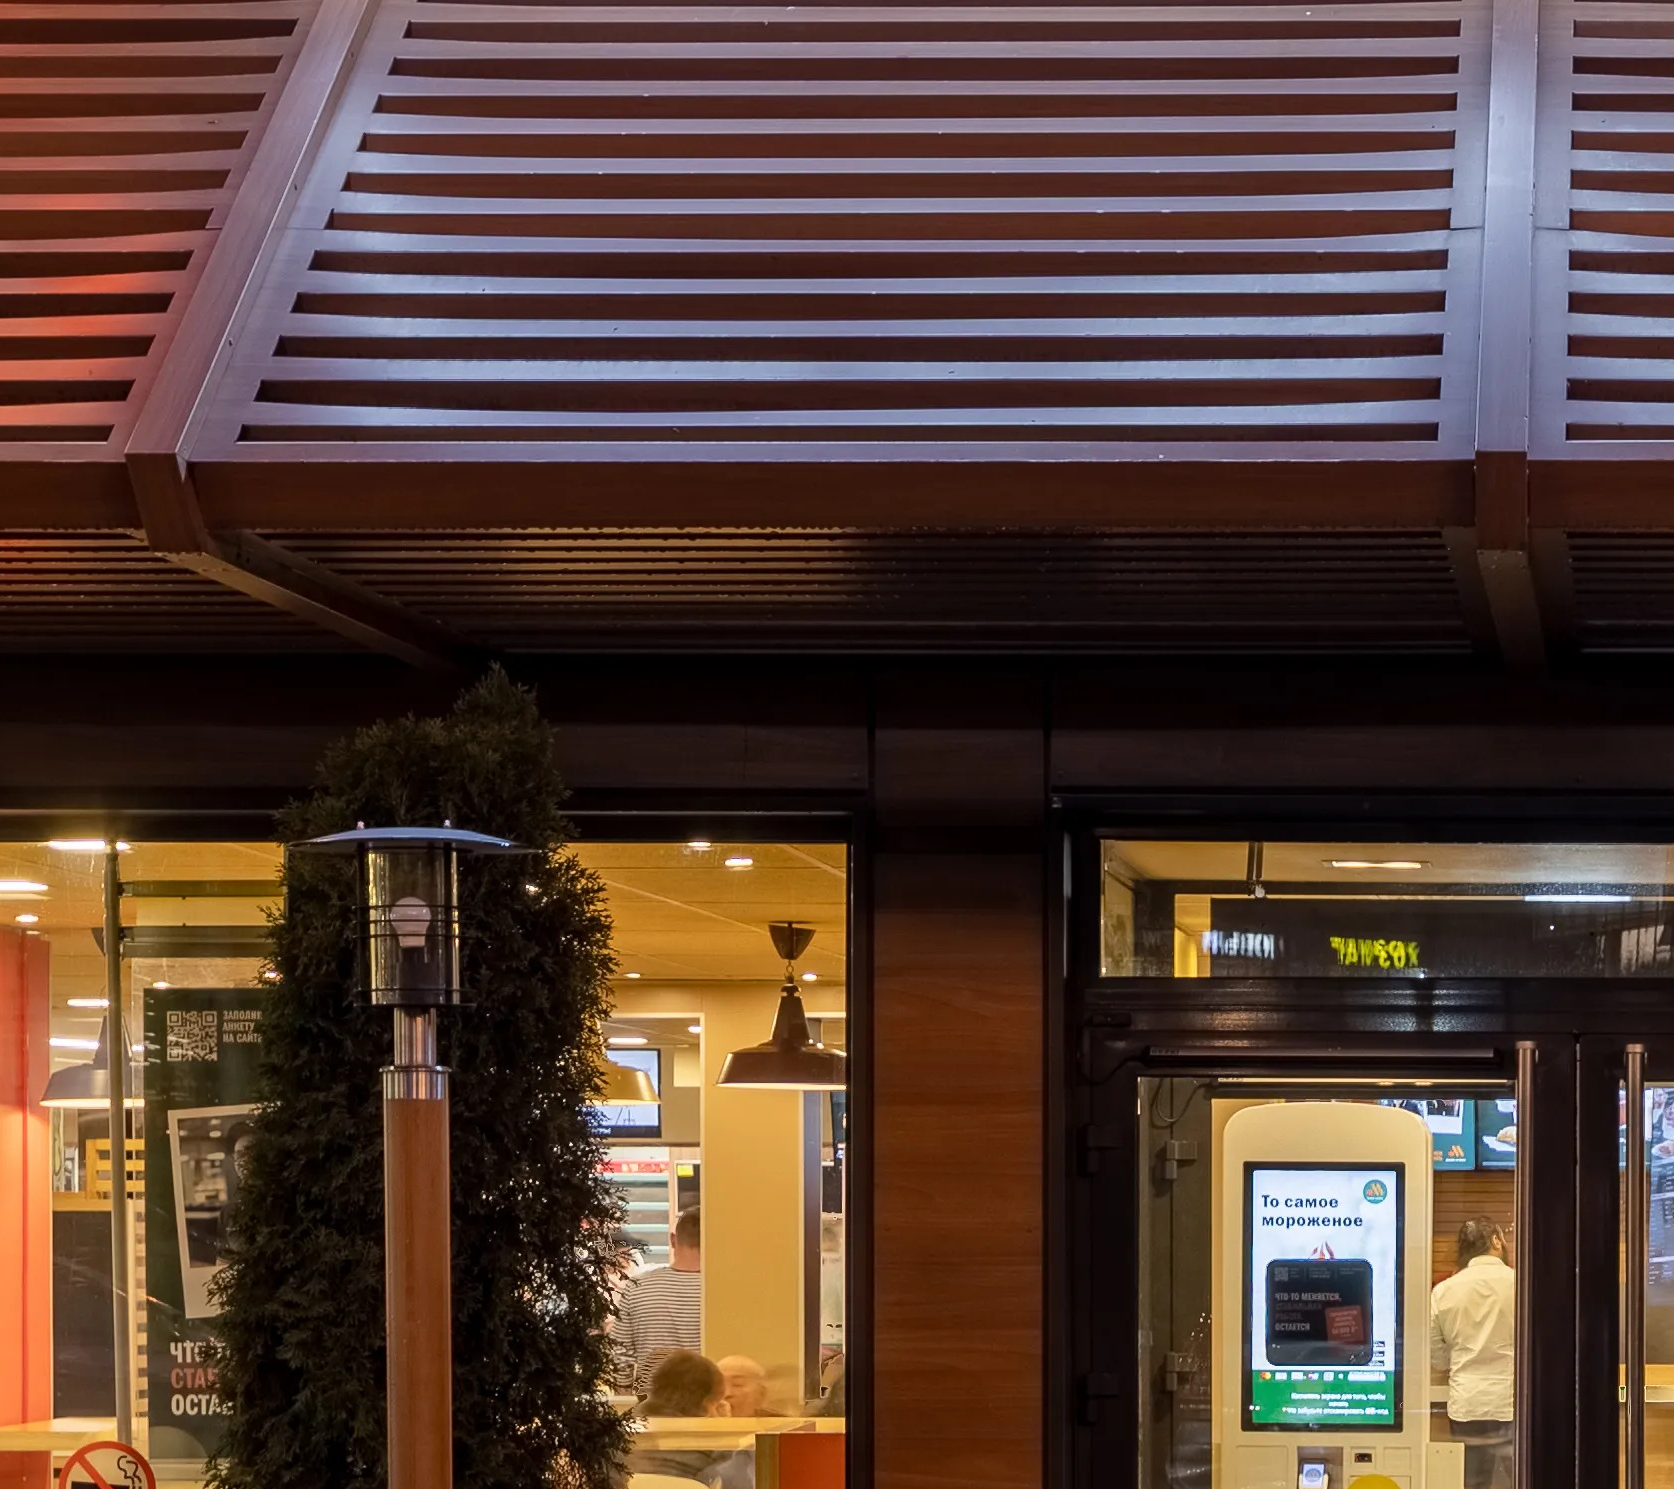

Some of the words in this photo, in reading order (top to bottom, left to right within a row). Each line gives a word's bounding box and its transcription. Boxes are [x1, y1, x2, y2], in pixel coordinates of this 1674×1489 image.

[222, 1033, 234, 1043] НА
[1262, 1195, 1279, 1208] То
[1285, 1198, 1338, 1208] самое
[1262, 1216, 1363, 1229] мороженое
